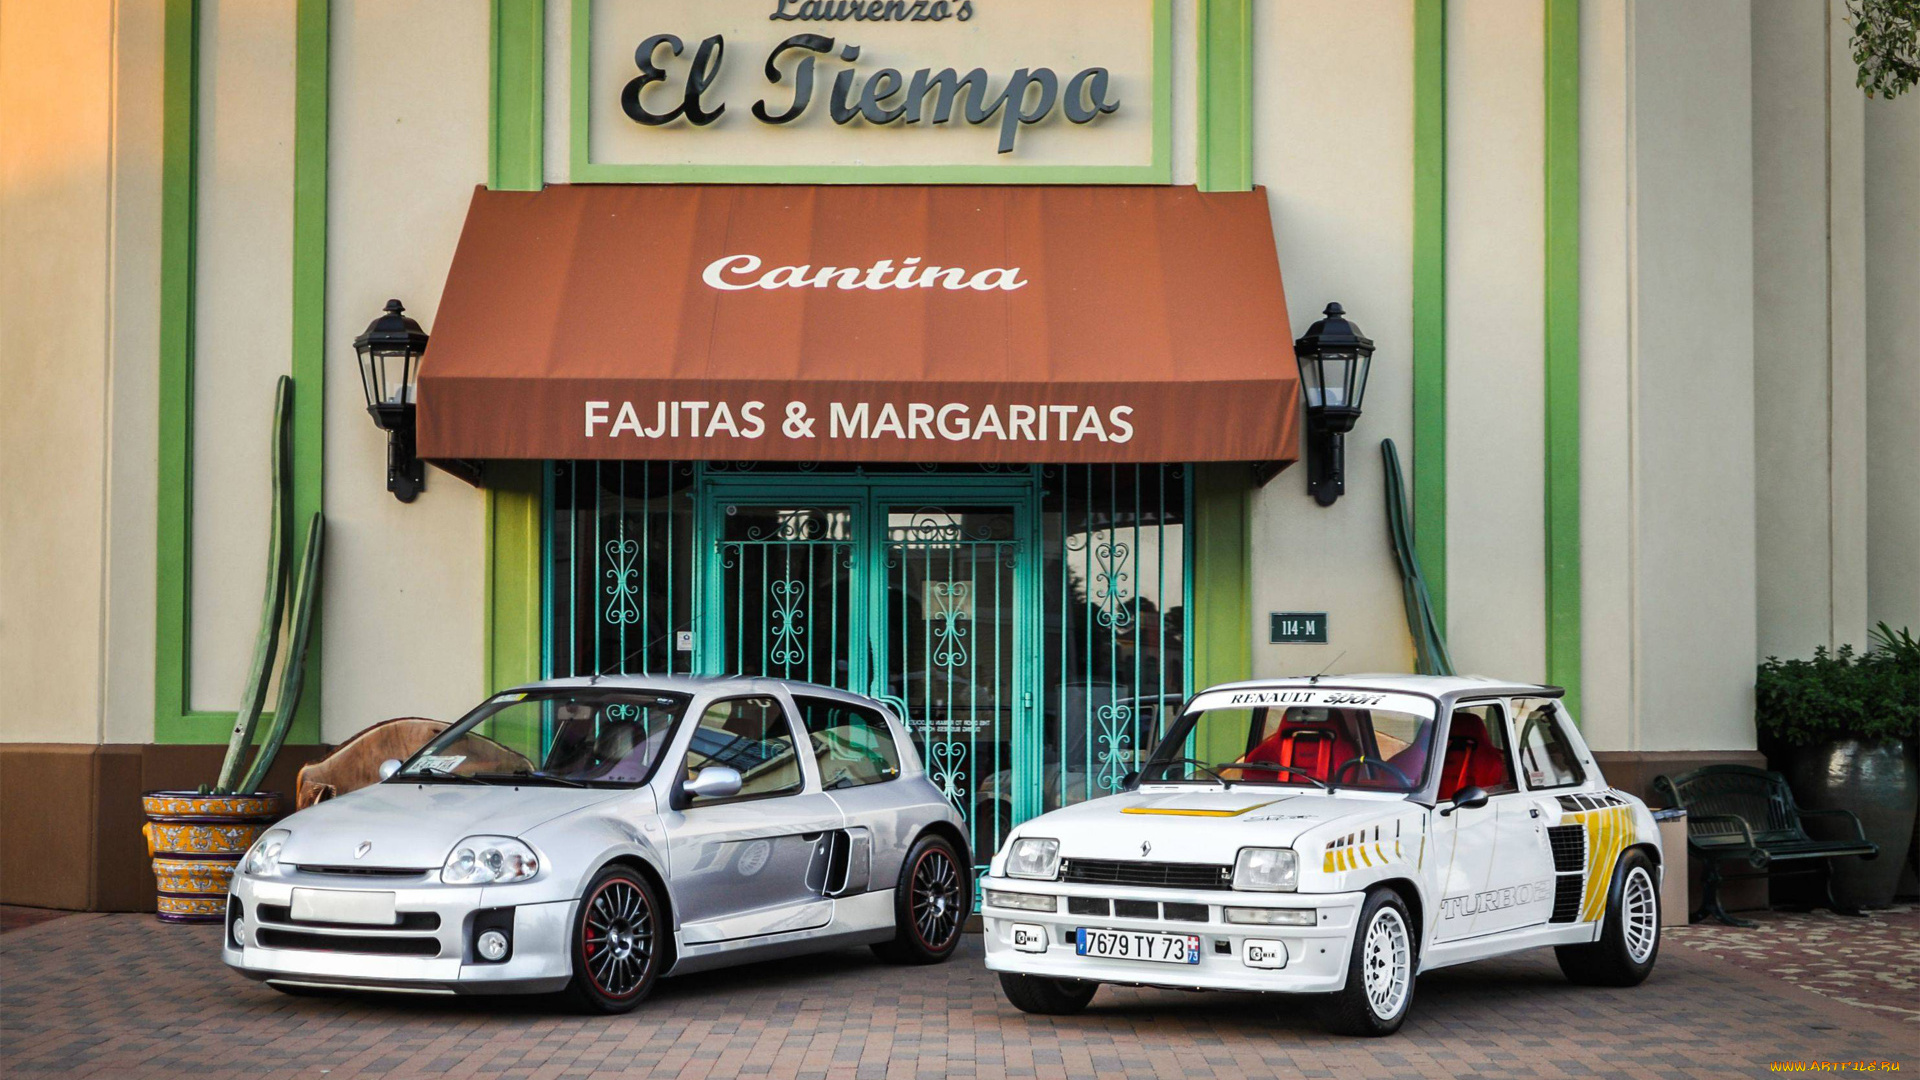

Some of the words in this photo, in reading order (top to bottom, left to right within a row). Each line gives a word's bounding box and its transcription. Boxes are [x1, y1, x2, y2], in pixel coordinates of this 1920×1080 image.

[620, 34, 726, 126] El
[751, 33, 1120, 154] Tiempo
[702, 254, 1028, 291] Cantina
[585, 401, 766, 438] FAJITAS
[781, 400, 816, 439] &
[829, 402, 1134, 443] MARGARITAS
[1282, 620, 1316, 635] 114-M
[1231, 692, 1316, 704] RENAULT
[1087, 932, 1129, 956] 7679
[1135, 936, 1155, 958] TY
[1162, 938, 1185, 960] 73
[1188, 951, 1198, 961] 73
